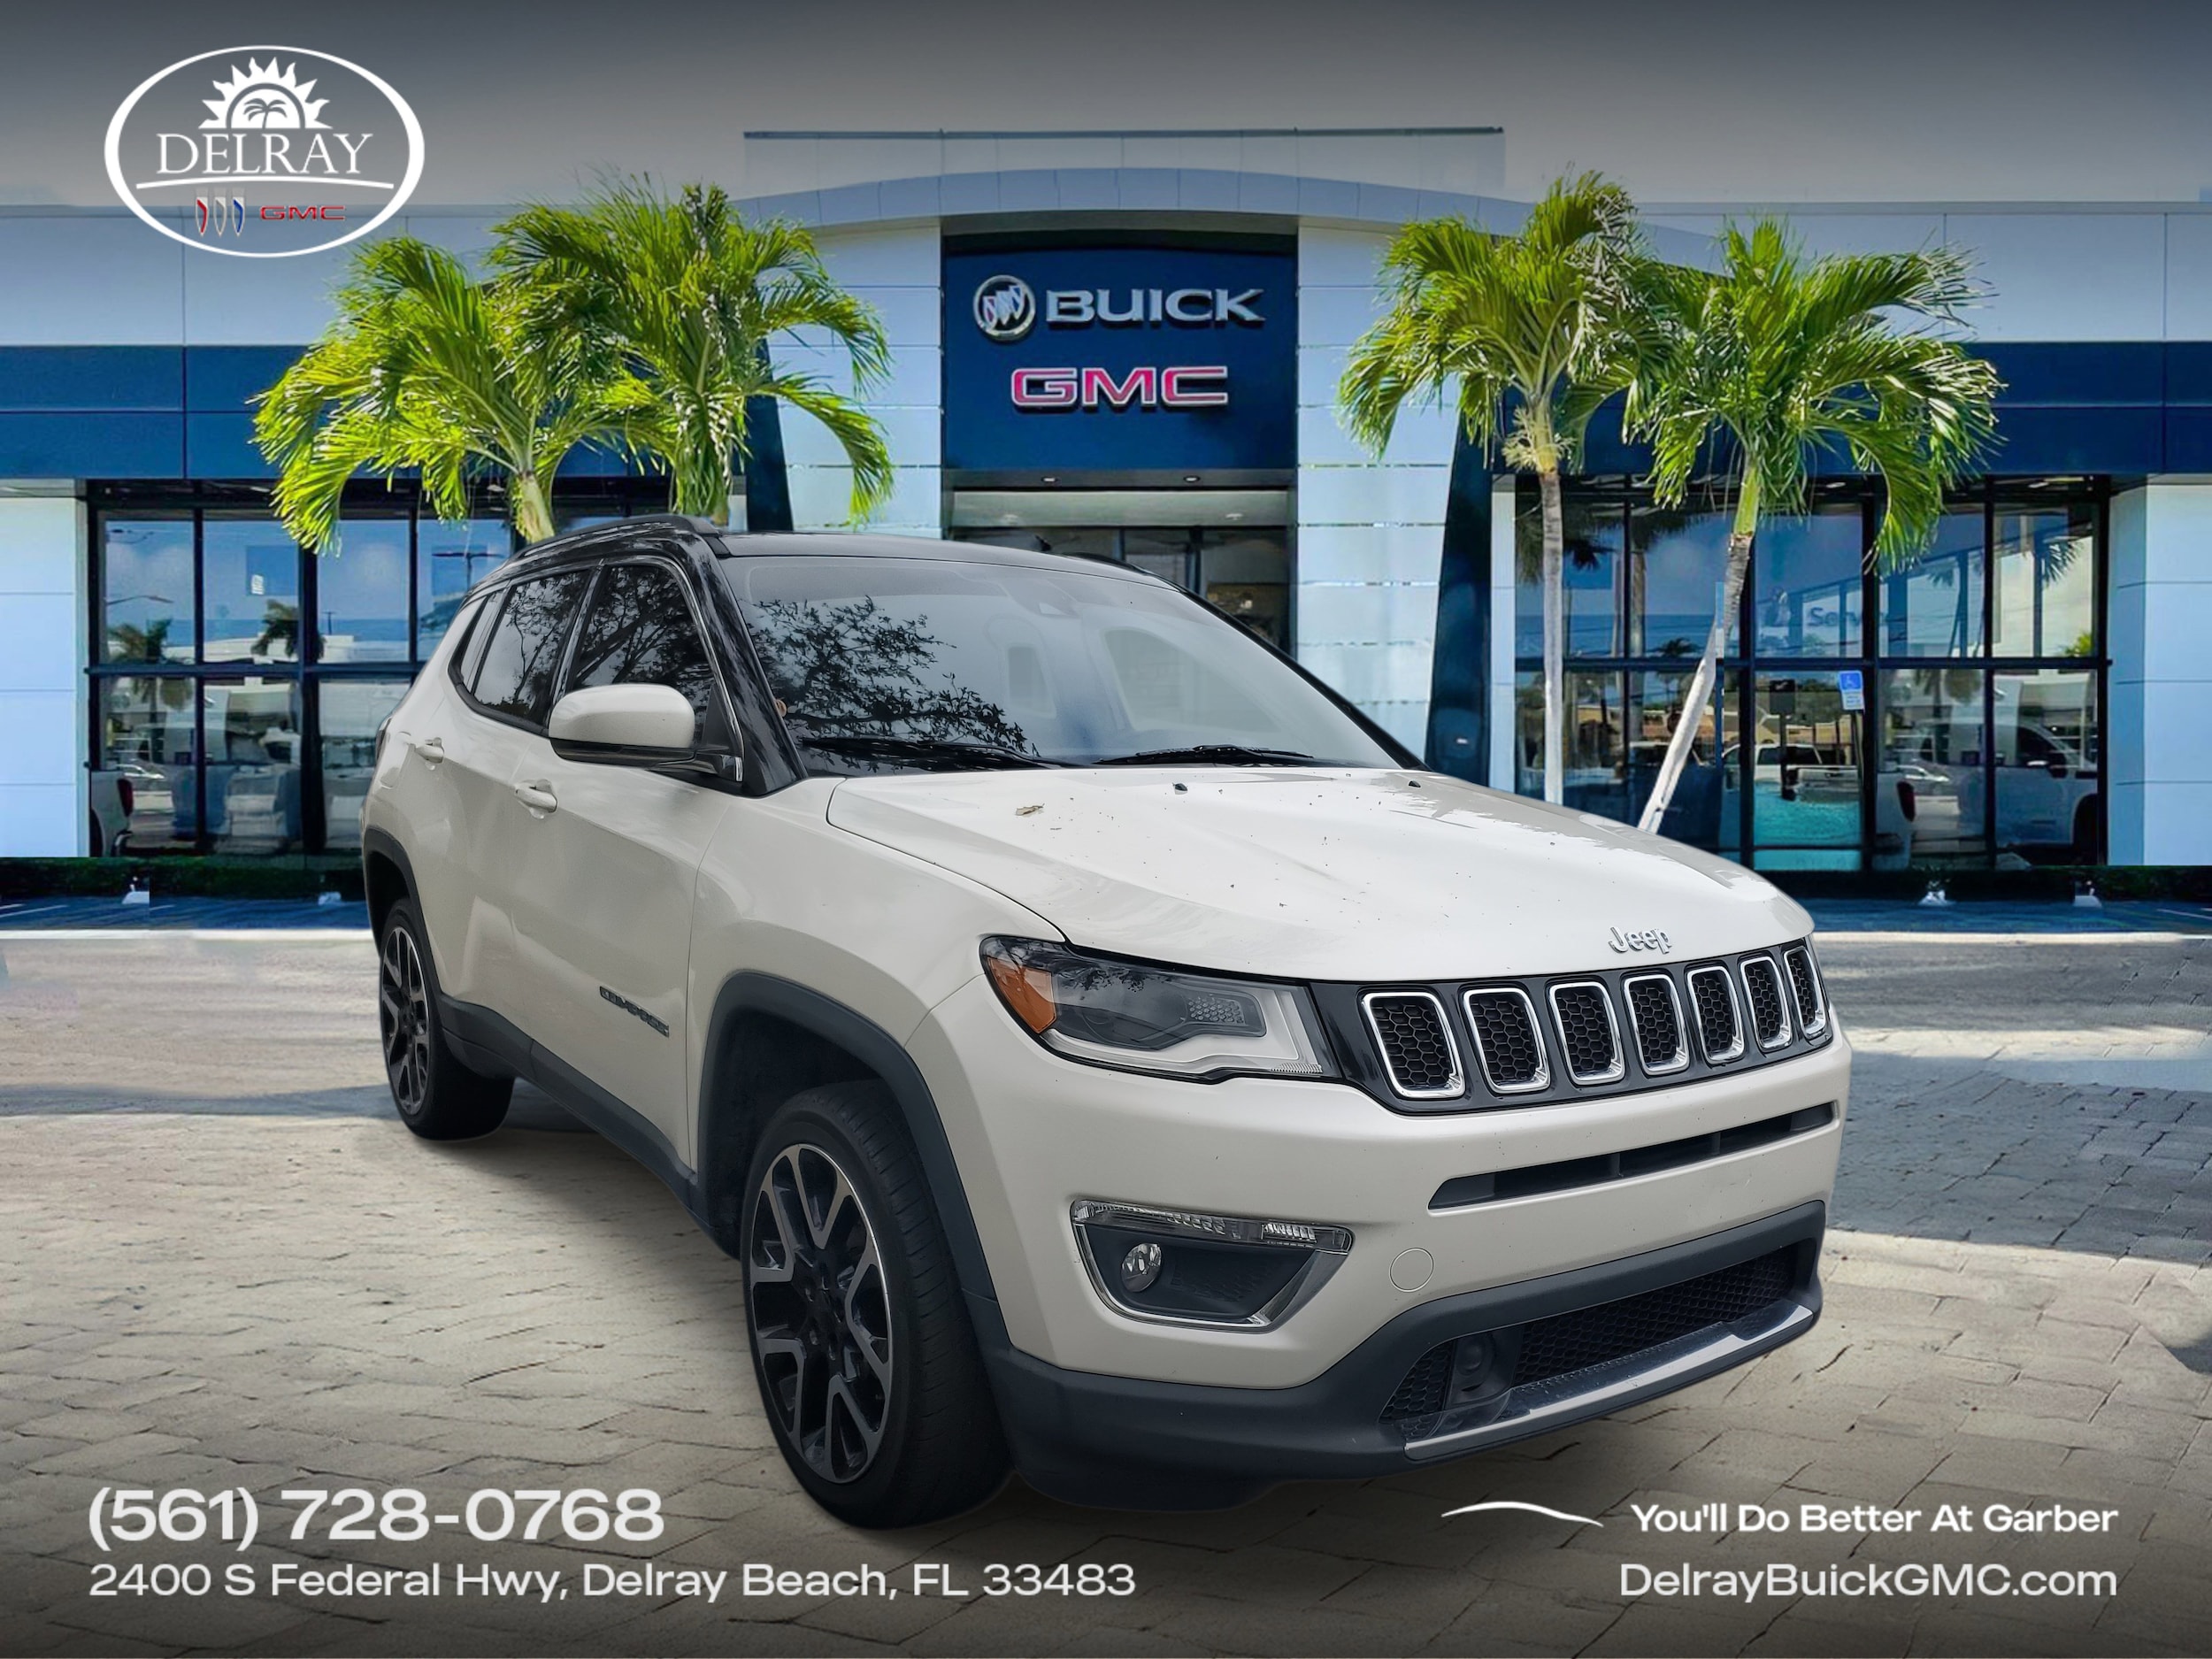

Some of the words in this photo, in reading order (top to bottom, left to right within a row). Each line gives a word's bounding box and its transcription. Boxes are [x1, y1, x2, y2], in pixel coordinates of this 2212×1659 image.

[1046, 288, 1266, 325] BUICK
[1010, 365, 1229, 407] GMC
[1608, 926, 1672, 955] Jeep
